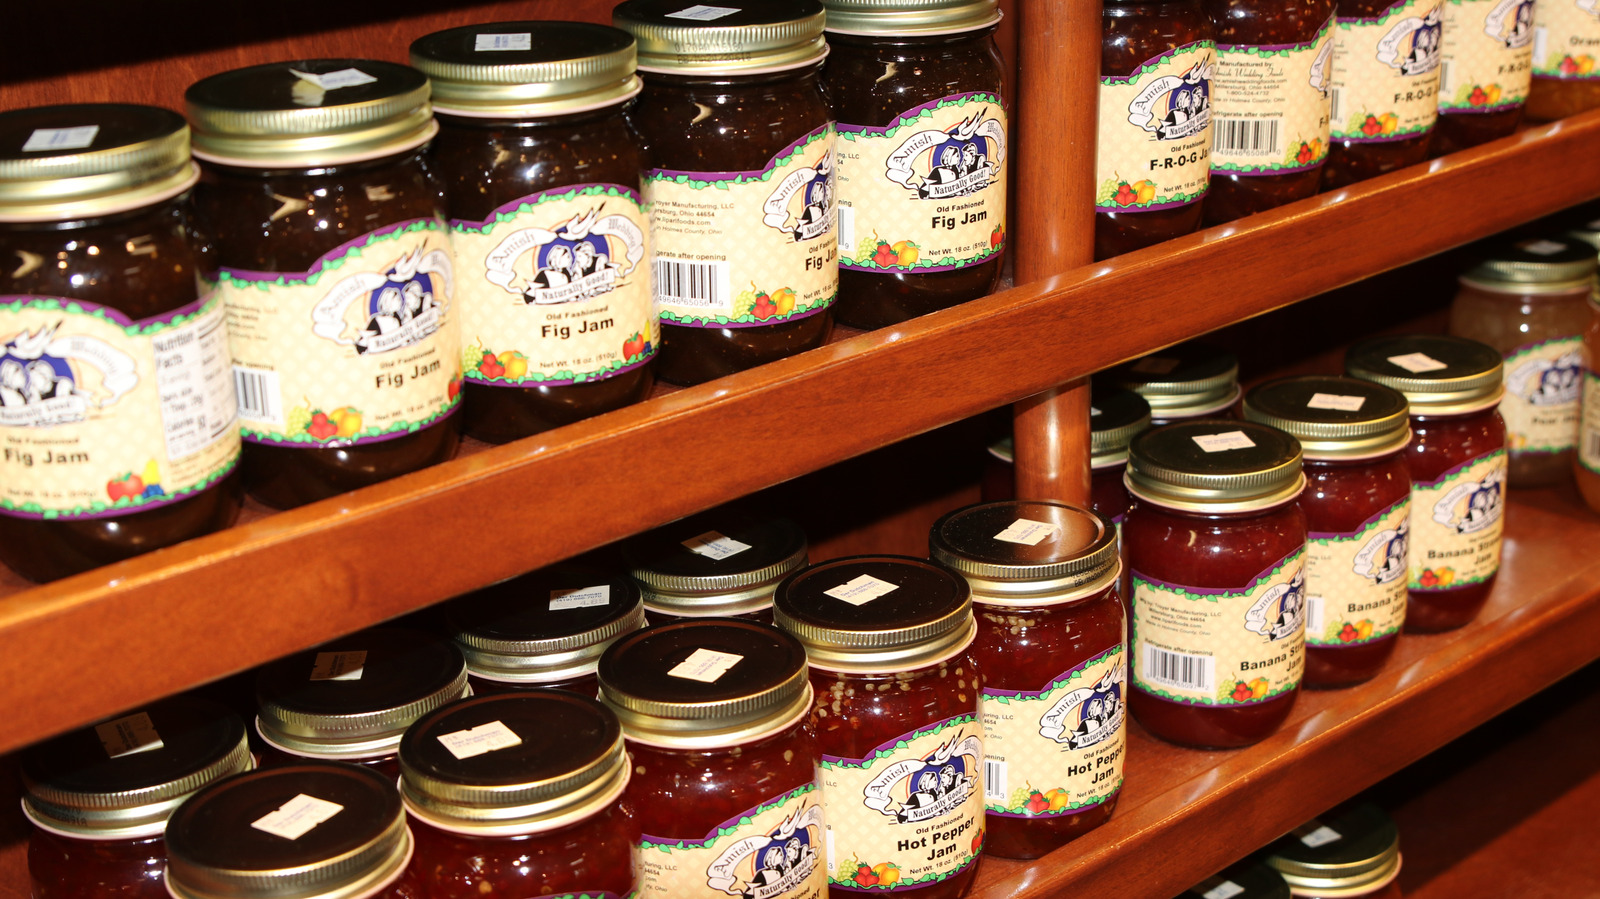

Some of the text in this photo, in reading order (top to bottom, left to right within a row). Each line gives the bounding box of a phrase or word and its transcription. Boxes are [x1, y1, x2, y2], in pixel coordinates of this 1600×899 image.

[1136, 78, 1170, 112] Amish
[1393, 87, 1432, 104] F-R-O-G
[1213, 110, 1243, 118] efrigerate
[1259, 111, 1283, 119] opening
[1169, 118, 1197, 136] Naturally
[893, 133, 933, 168] Amish
[1182, 139, 1205, 150] Fashioned
[1150, 149, 1208, 170] F-R-O-G Ja
[934, 169, 986, 195] Naturally Good!
[770, 171, 805, 213] Amish
[655, 200, 671, 208] royer
[672, 202, 720, 210] Manufacturing,
[838, 199, 852, 207] ning
[951, 199, 984, 211] Fashioned
[655, 216, 711, 226] w.liparifoods.com
[931, 210, 987, 229] Fig Jam
[491, 229, 536, 269] Amish
[656, 250, 676, 258] gerate
[808, 245, 818, 254] Old
[805, 256, 823, 271] Fig
[541, 271, 610, 301] Naturally Good!
[546, 305, 609, 321] Old Fashioned
[541, 317, 615, 340] Fig Jam
[375, 357, 442, 389] Fig Jam
[540, 361, 555, 369] Net
[4, 448, 90, 466] Fig Jam
[1427, 547, 1474, 559] Banana
[1250, 587, 1281, 617] Amish
[1348, 597, 1391, 613] Banana
[1171, 606, 1209, 617] Manufacturing,
[1173, 645, 1187, 653] after
[1240, 653, 1287, 671] Banana
[1046, 692, 1082, 728] Amish
[1081, 724, 1108, 744] Naturally
[1083, 738, 1119, 760] Old Fashioned
[1067, 762, 1092, 777] Hot
[1091, 767, 1114, 784] Jam
[871, 763, 910, 796] Amish
[912, 786, 965, 818] Naturally Good!
[916, 813, 964, 835] Old Fashioned
[897, 816, 975, 851] Hot Pepper
[714, 840, 754, 877] Amish
[927, 843, 957, 861] Jam
[759, 872, 793, 897] Naturally
[793, 860, 811, 877] Good!
[910, 867, 922, 875] Net
